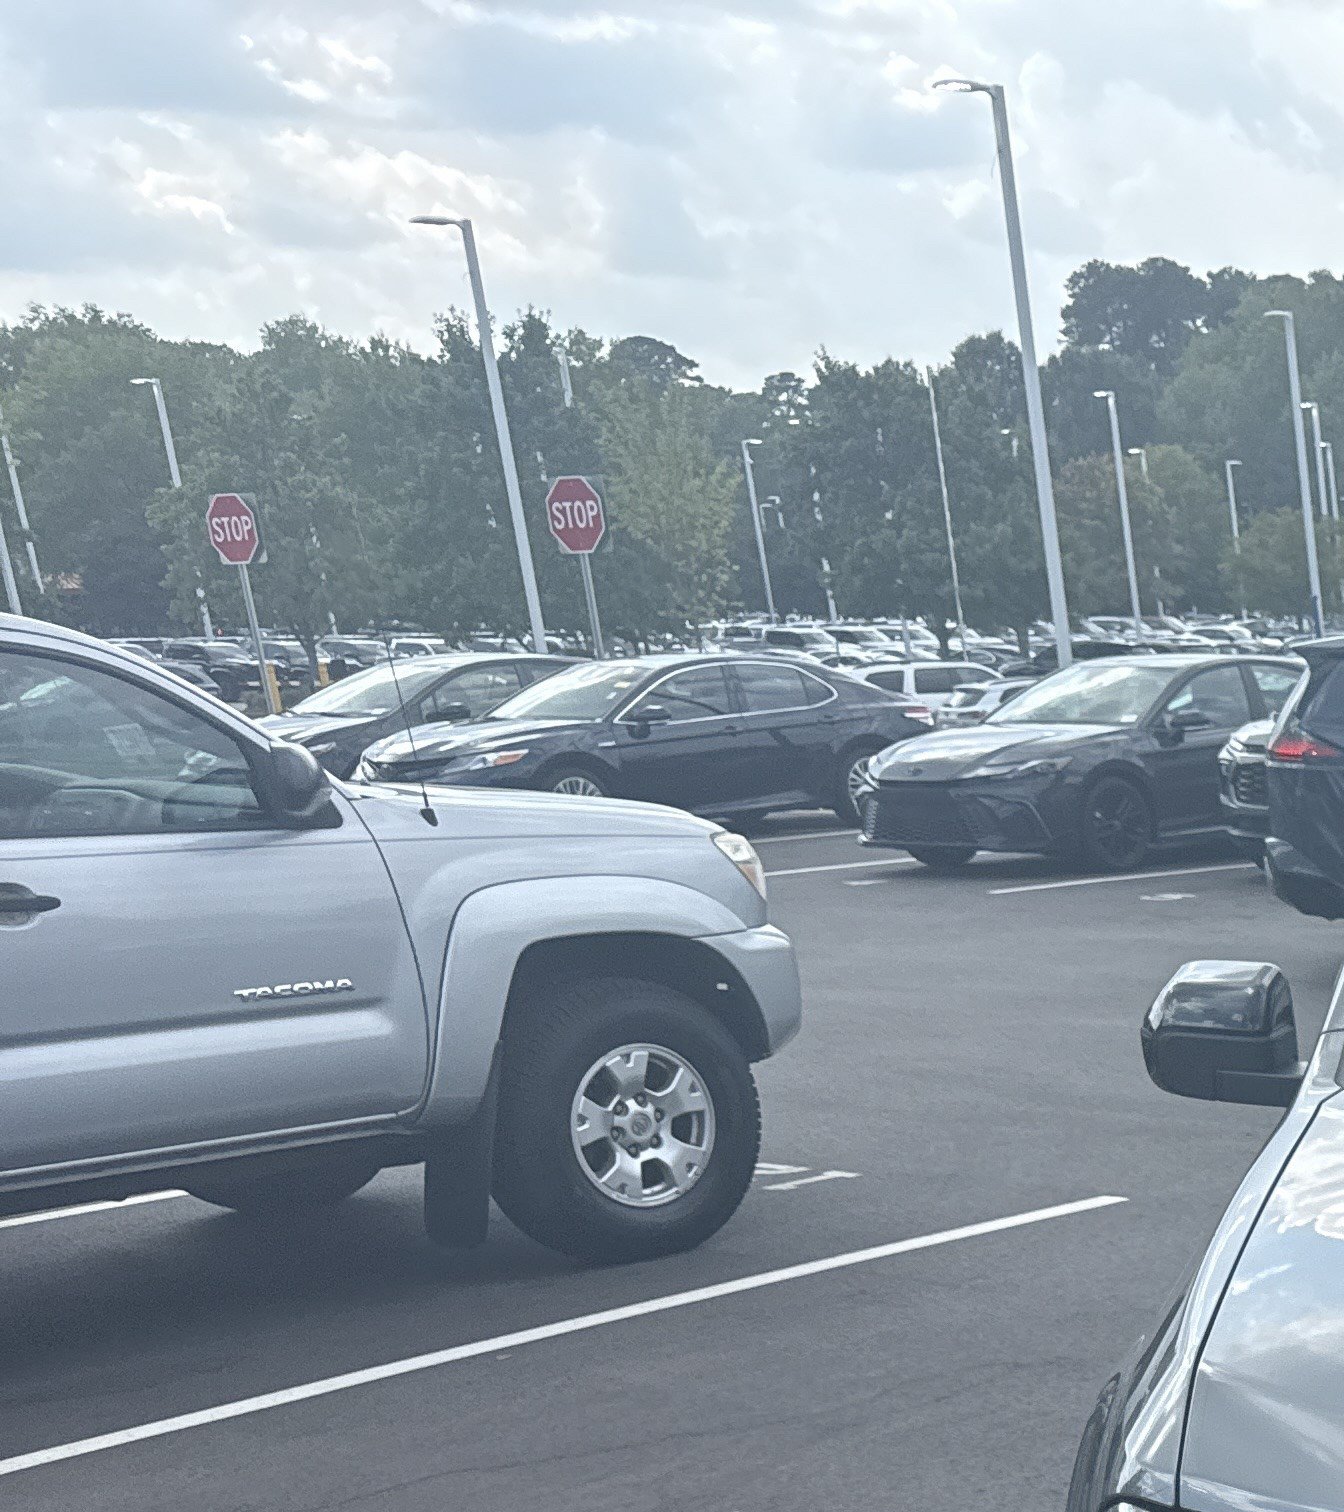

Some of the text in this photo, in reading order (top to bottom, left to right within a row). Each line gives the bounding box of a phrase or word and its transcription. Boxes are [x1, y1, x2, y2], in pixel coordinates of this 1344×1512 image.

[551, 499, 598, 530] STOP
[211, 515, 252, 543] STOP
[233, 978, 355, 1001] TACOMA
